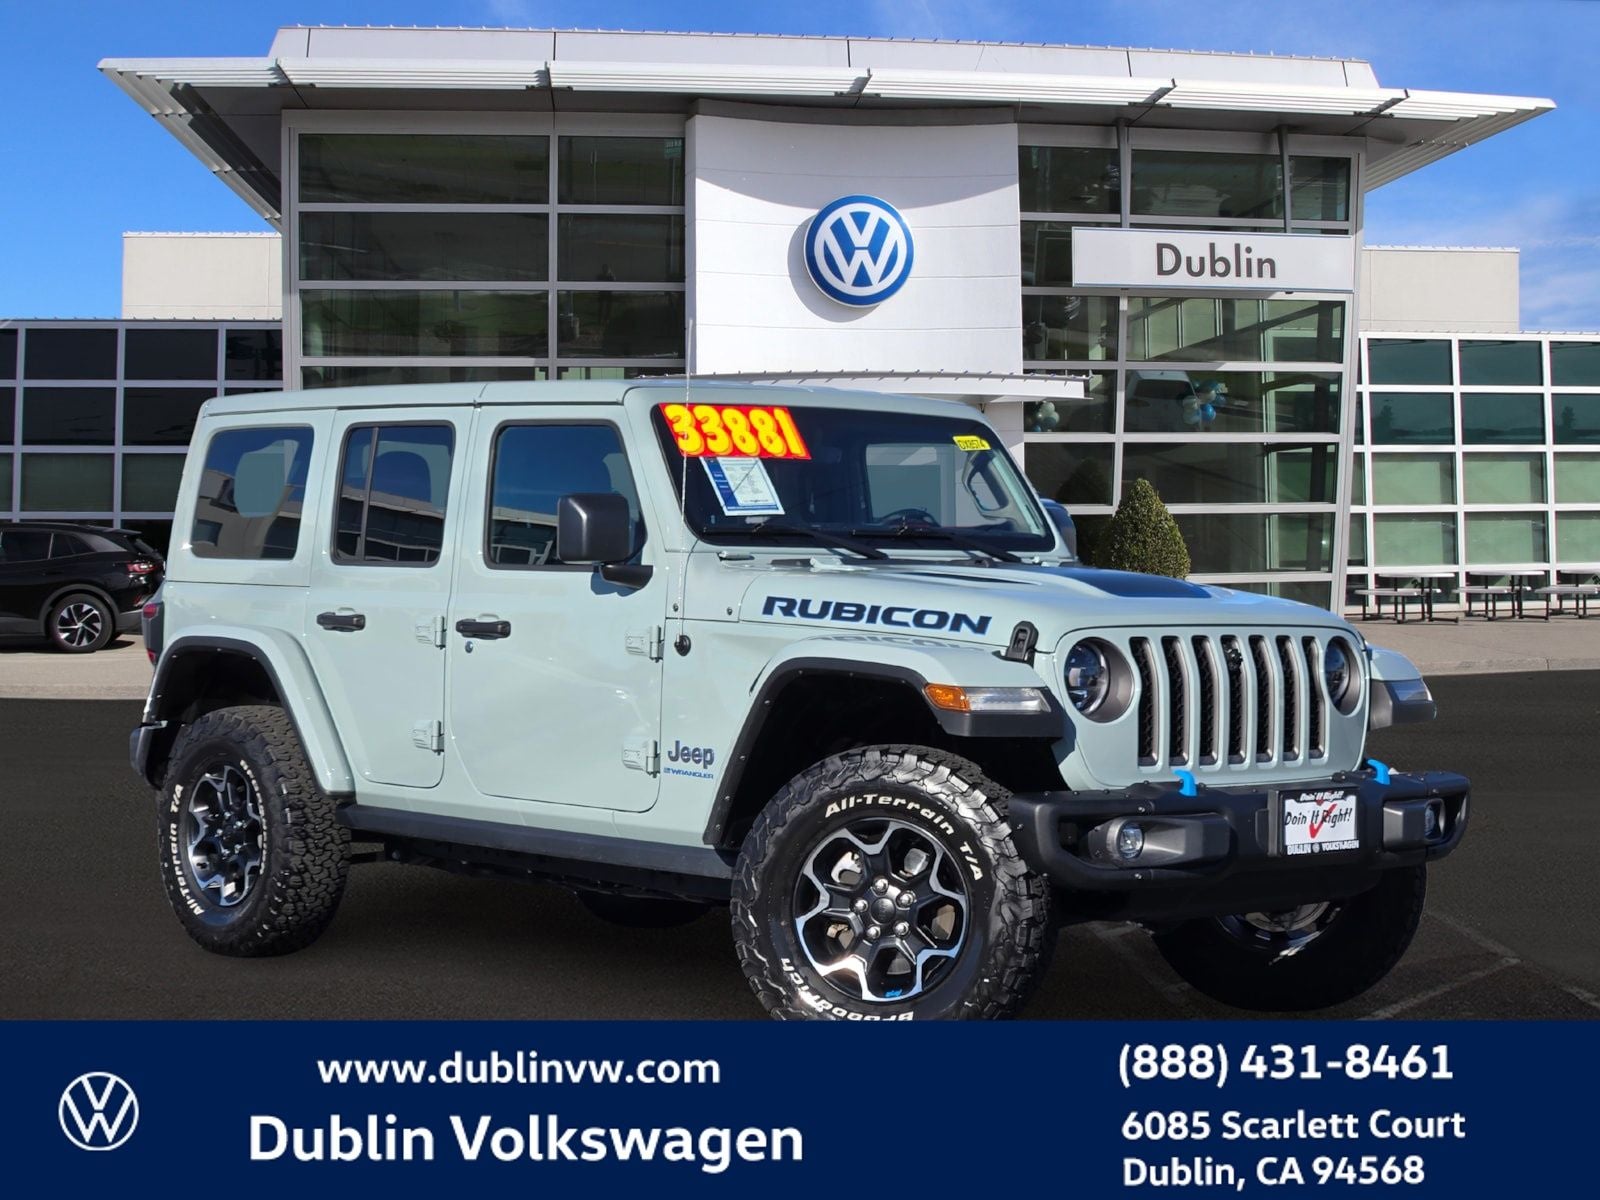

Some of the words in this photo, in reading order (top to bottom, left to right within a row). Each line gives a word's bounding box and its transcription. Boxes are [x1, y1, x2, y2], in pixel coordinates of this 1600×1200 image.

[811, 204, 909, 294] VW
[1156, 243, 1276, 280] Dublin
[664, 404, 807, 457] 33881
[762, 596, 992, 635] RUBICON
[668, 740, 714, 769] Jeep
[671, 769, 714, 779] WRANGLER
[1311, 810, 1320, 824] It
[1323, 808, 1353, 828] Right!
[825, 793, 955, 836] All-Terrain
[959, 841, 984, 881] T/A
[1322, 840, 1359, 851] VOLKSWAGEN
